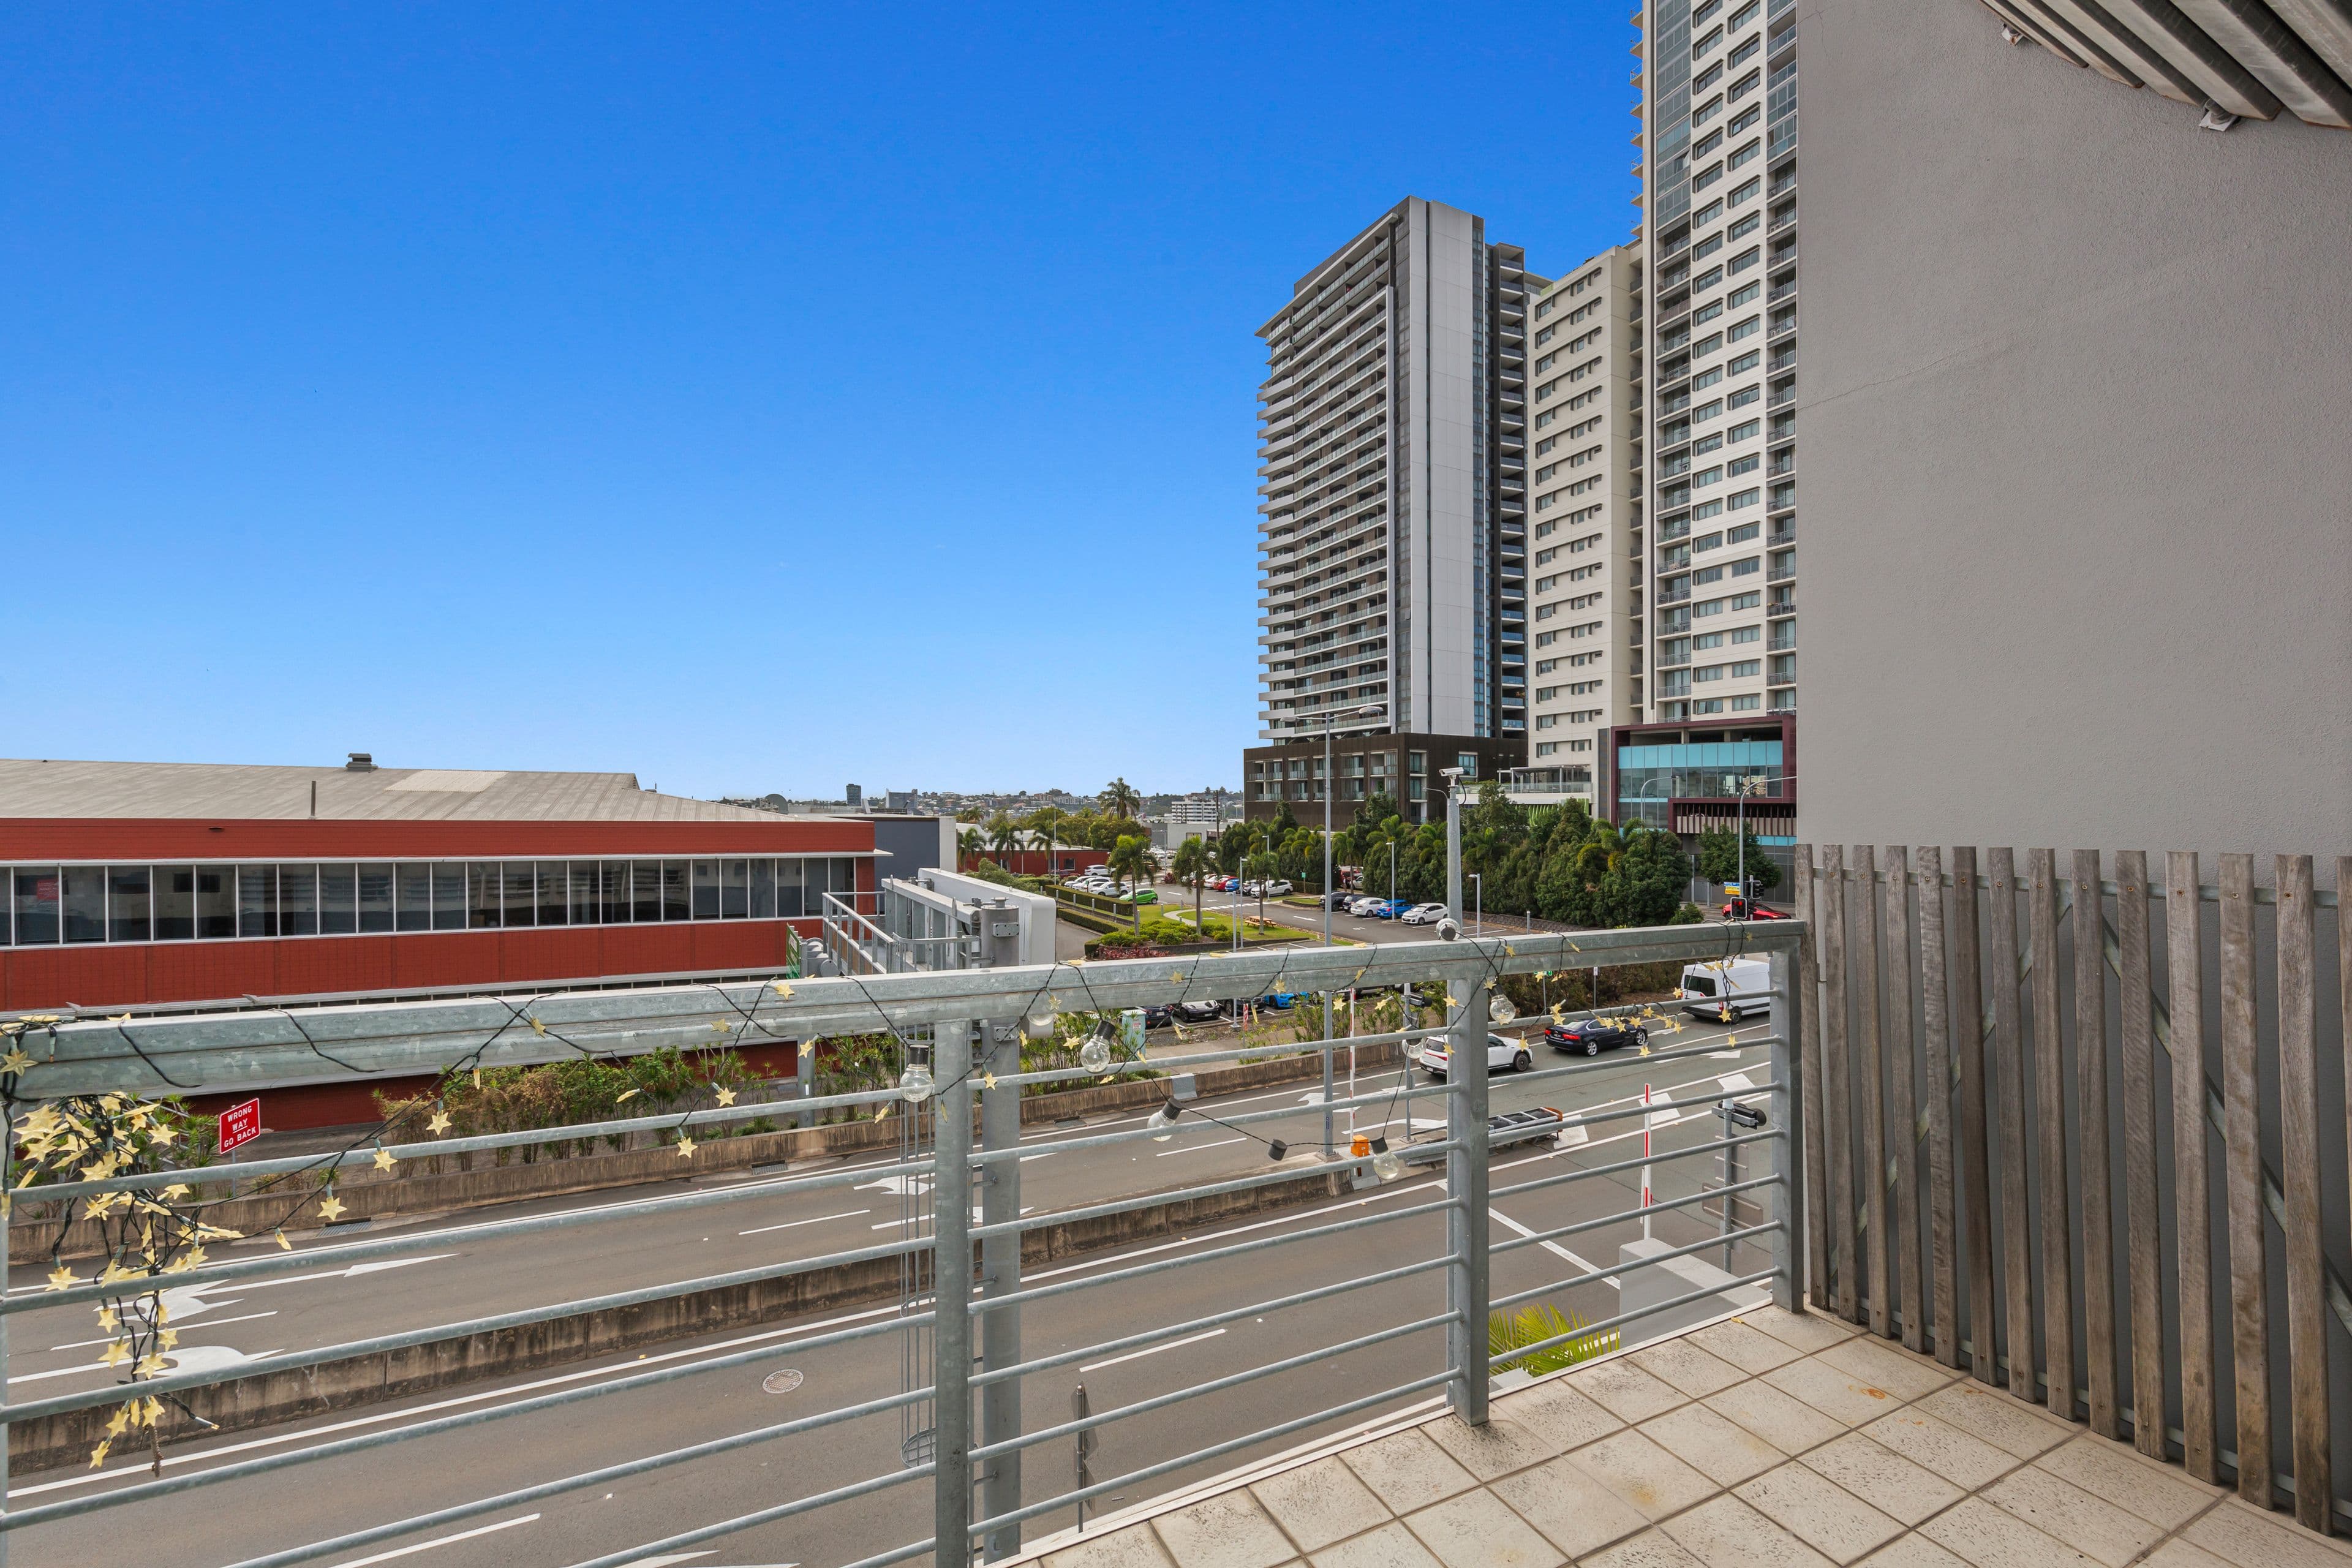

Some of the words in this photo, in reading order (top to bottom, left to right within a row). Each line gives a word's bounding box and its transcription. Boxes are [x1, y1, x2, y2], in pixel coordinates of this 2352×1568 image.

[227, 1106, 252, 1122] WRONG
[232, 1118, 248, 1131] WAY
[224, 1137, 233, 1147] GO
[237, 1127, 256, 1141] BACK
